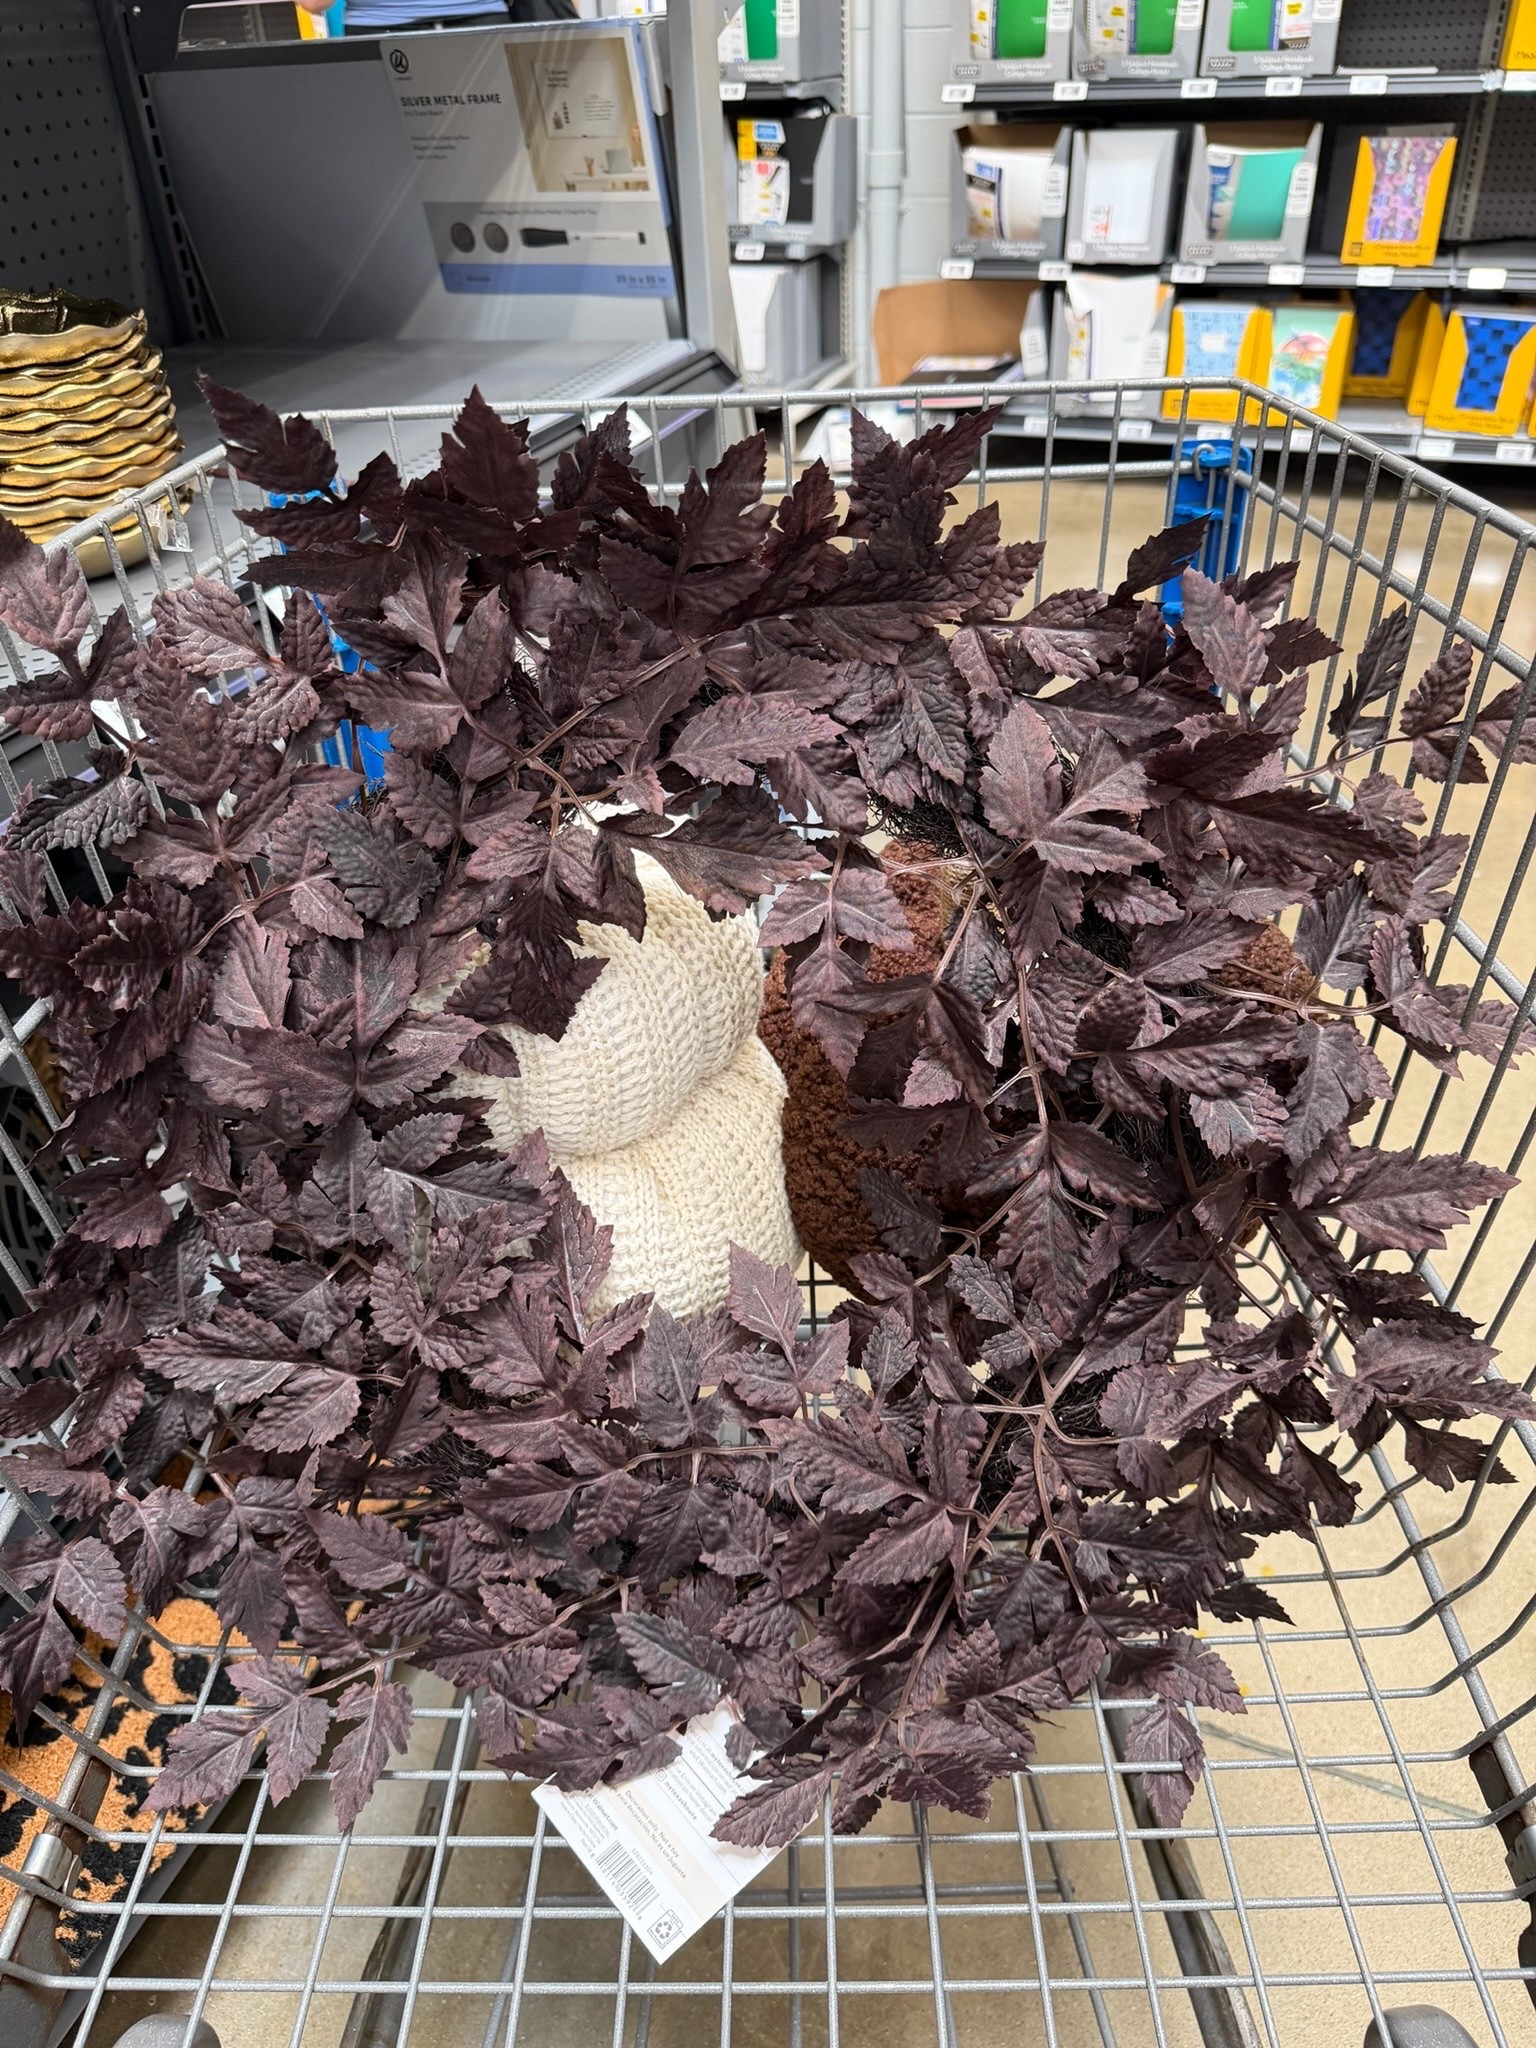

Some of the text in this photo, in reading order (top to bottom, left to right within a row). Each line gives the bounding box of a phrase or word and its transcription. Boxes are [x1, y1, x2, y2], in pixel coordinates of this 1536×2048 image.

[400, 93, 502, 107] SILVER METAL FRAME
[616, 1792, 628, 1806] para
[649, 1832, 660, 1844] No
[666, 1855, 688, 1880] juguete
[624, 1789, 650, 1820] Decoration
[658, 1831, 670, 1844] Not
[669, 1846, 680, 1859] toy
